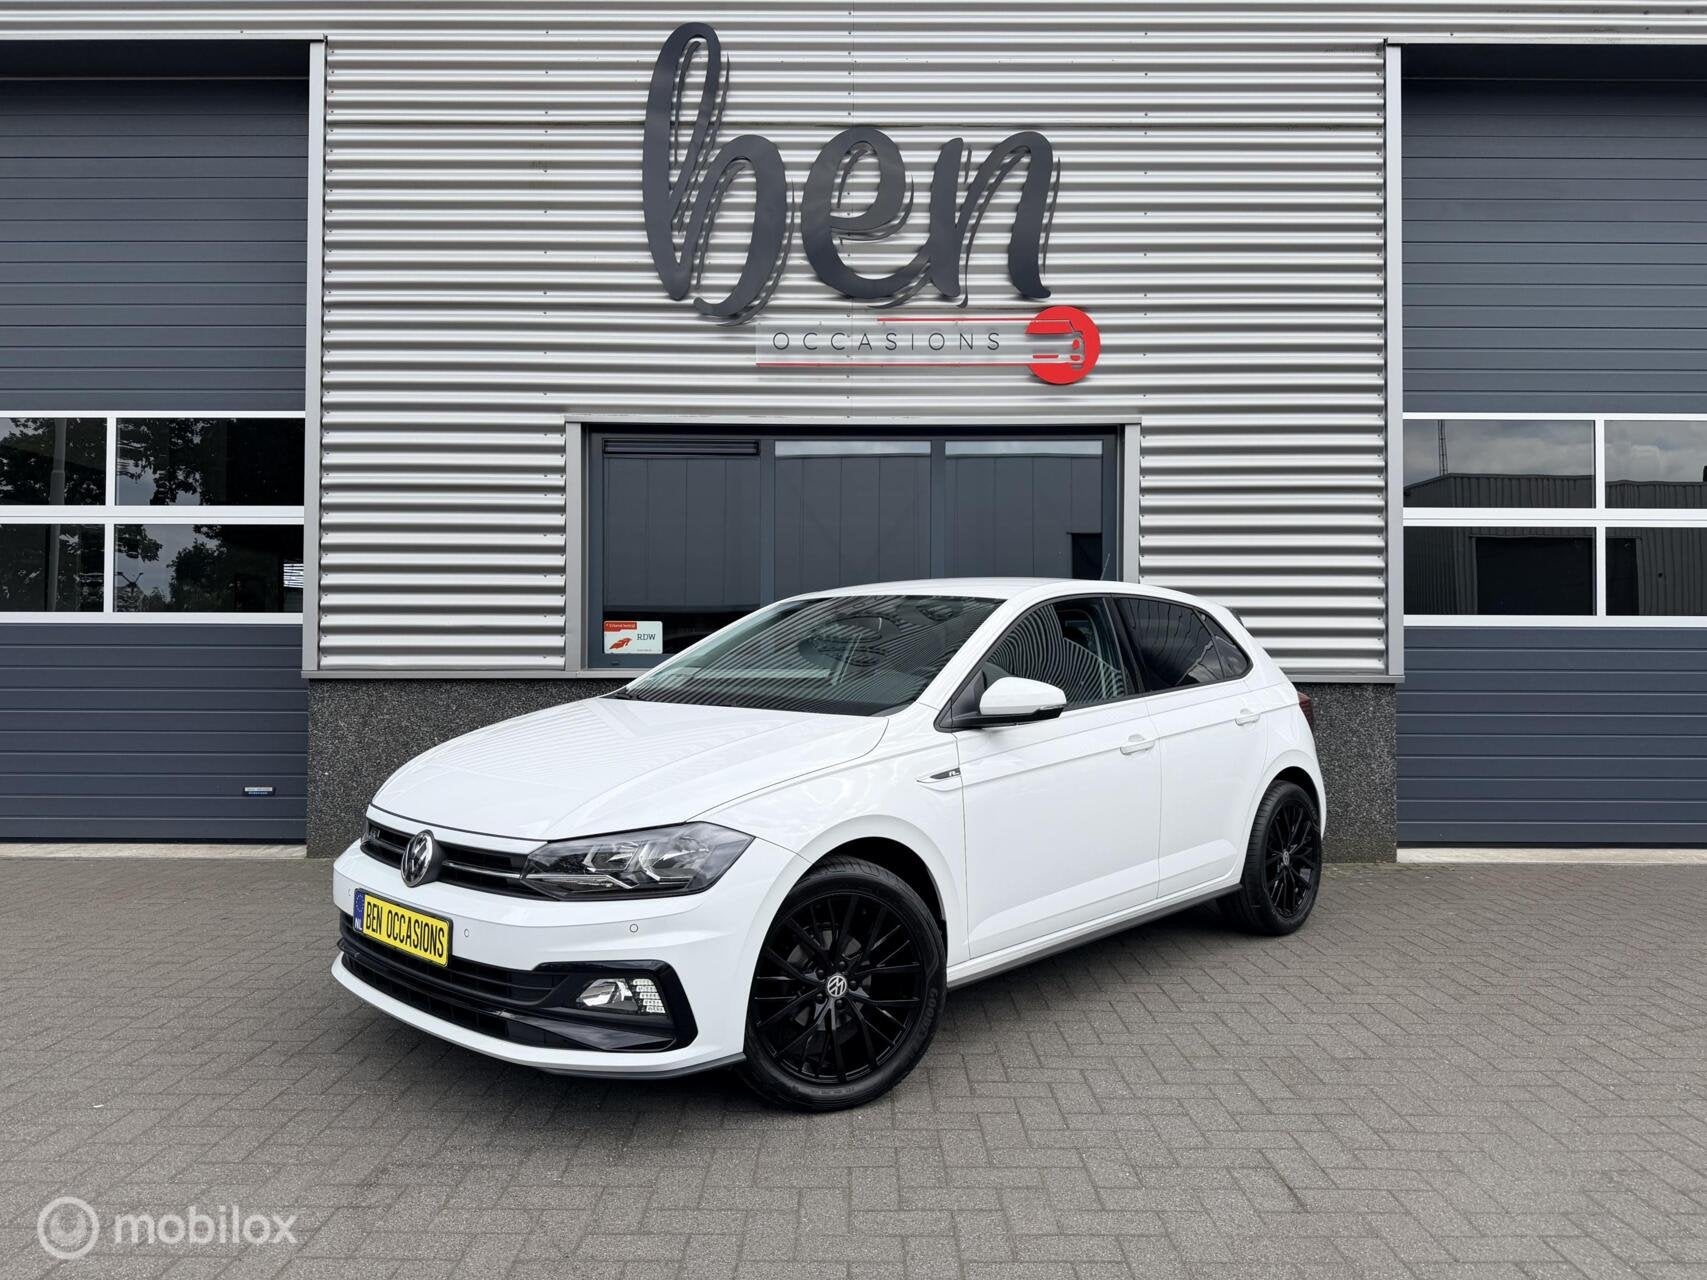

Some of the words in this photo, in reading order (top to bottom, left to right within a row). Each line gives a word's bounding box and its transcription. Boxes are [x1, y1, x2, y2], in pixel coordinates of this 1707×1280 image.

[642, 22, 1056, 318] ben
[772, 331, 1000, 351] OCCASIONS
[637, 633, 656, 641] RDW
[354, 917, 363, 931] NL
[366, 901, 383, 936] BEN
[386, 909, 445, 959] OCCASIONS
